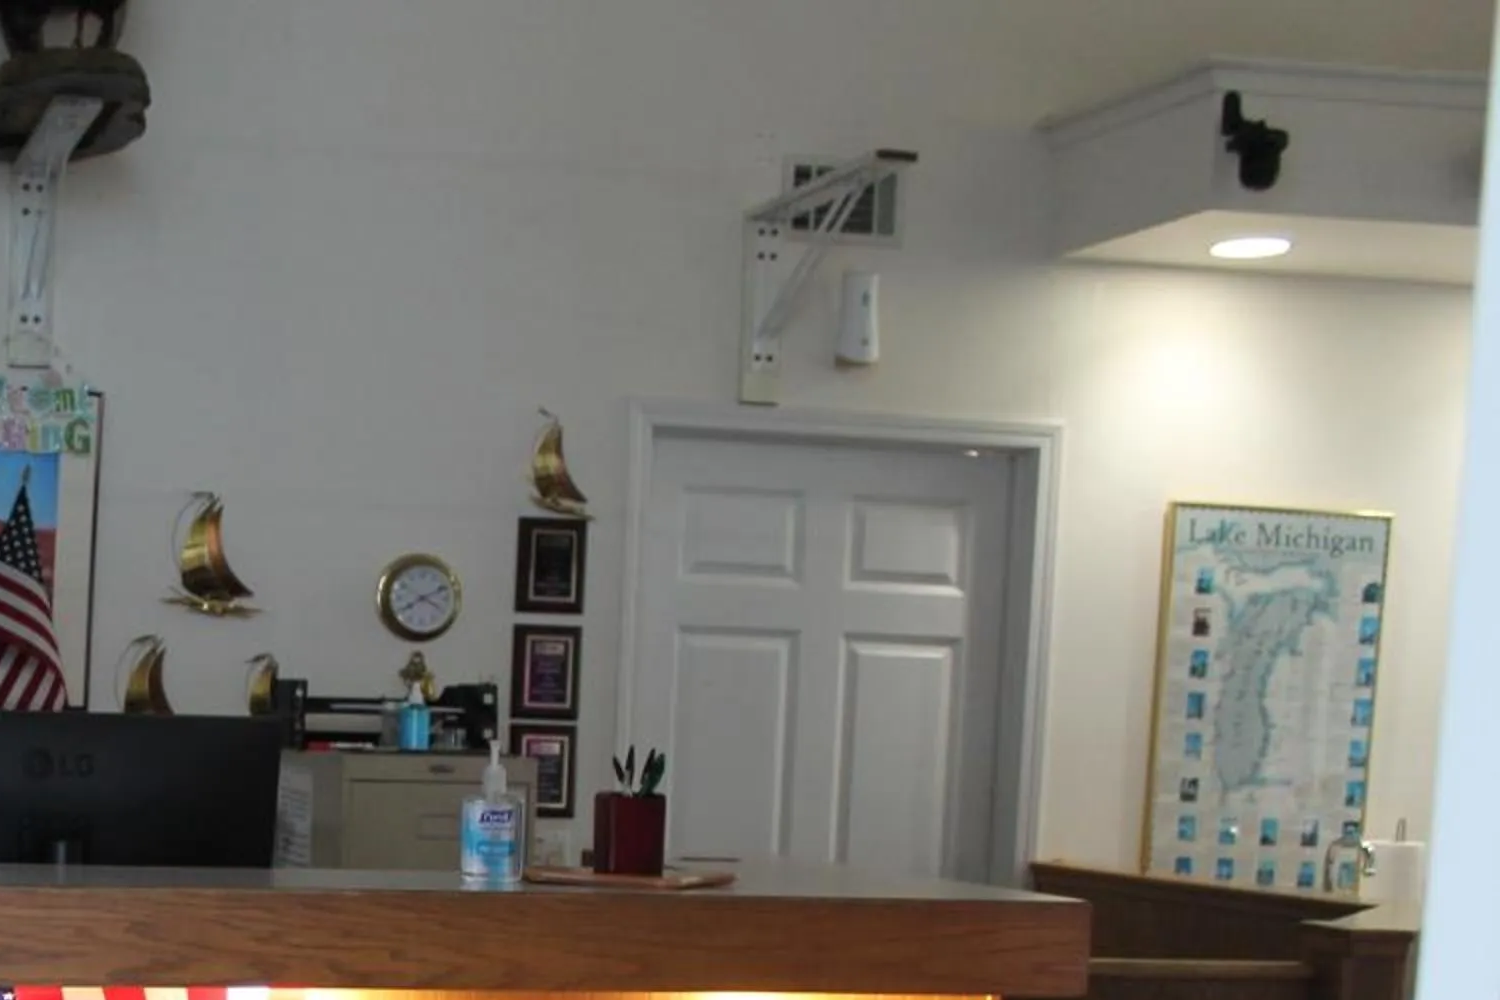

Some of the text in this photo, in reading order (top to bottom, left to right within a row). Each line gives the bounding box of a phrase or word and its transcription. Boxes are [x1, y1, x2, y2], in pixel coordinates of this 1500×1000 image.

[1189, 518, 1375, 559] Lake Michigan
[58, 752, 95, 778] LG
